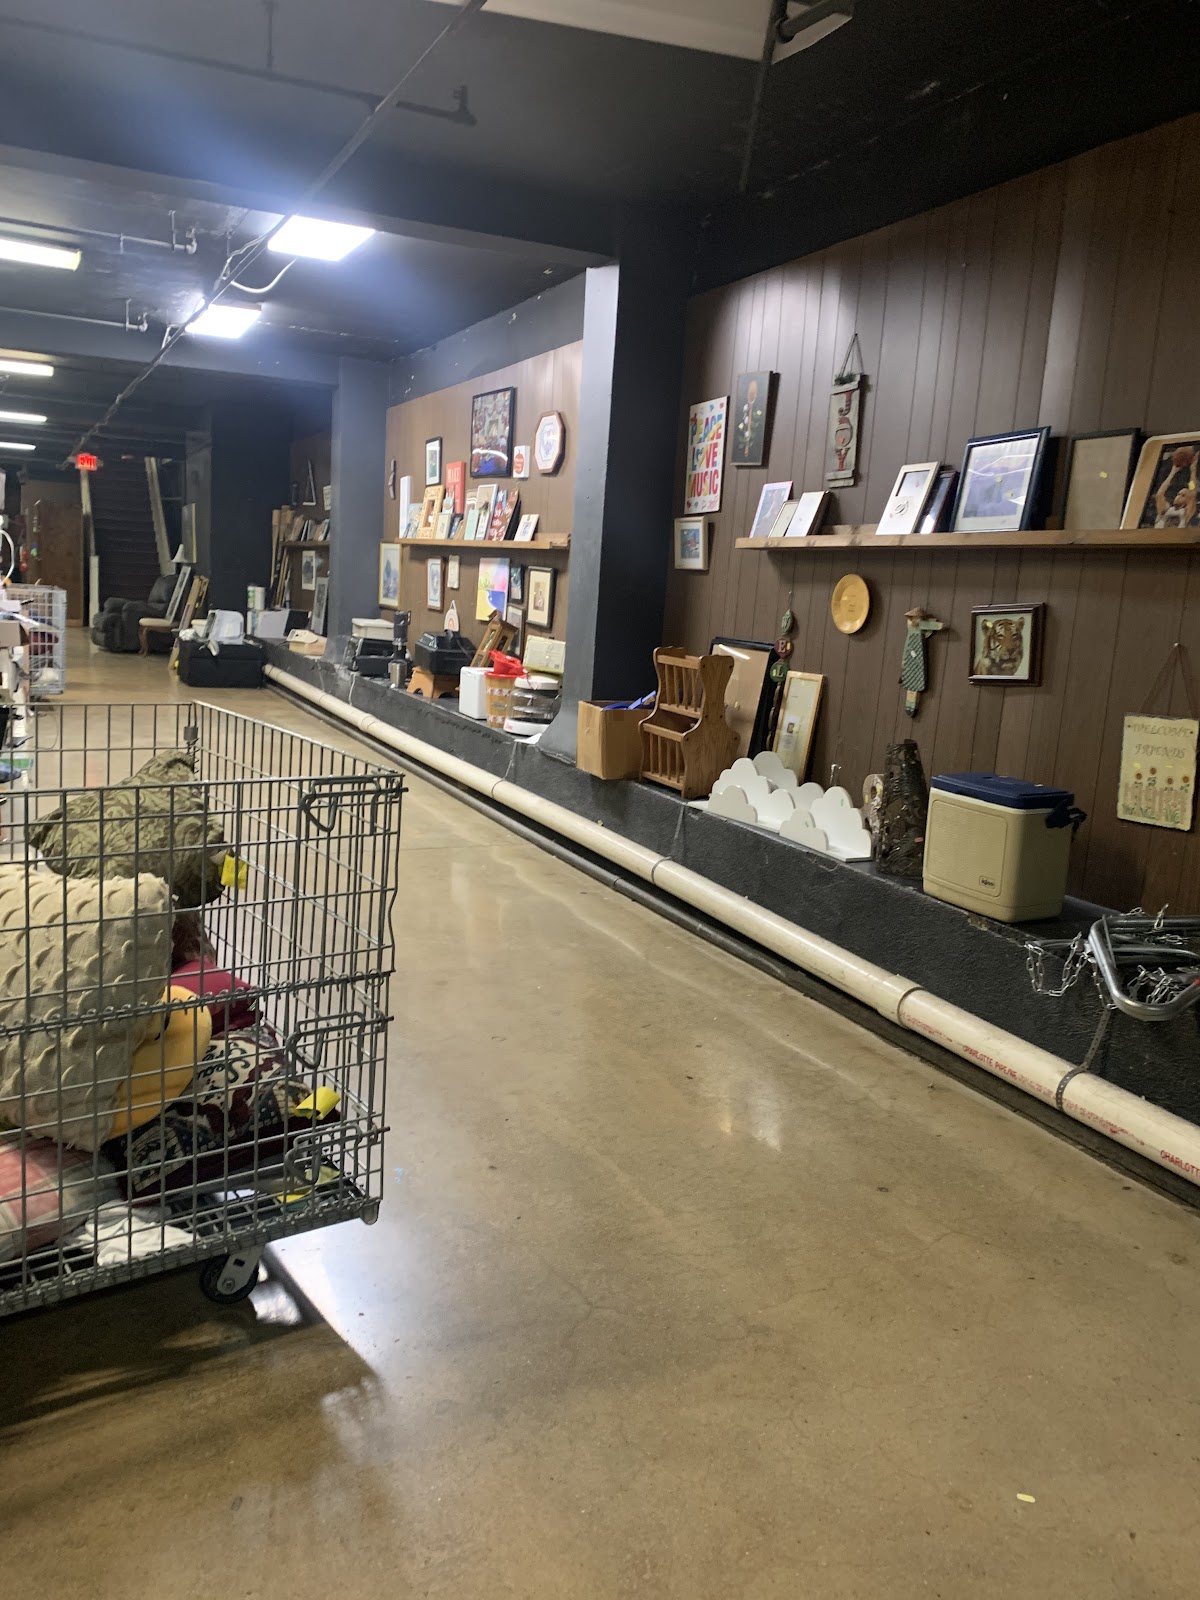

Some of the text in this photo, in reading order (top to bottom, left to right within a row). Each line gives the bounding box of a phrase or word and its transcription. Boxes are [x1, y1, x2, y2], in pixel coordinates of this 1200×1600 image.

[690, 413, 723, 446] PEACE
[691, 441, 719, 471] LOVE
[688, 469, 719, 499] MUSIC
